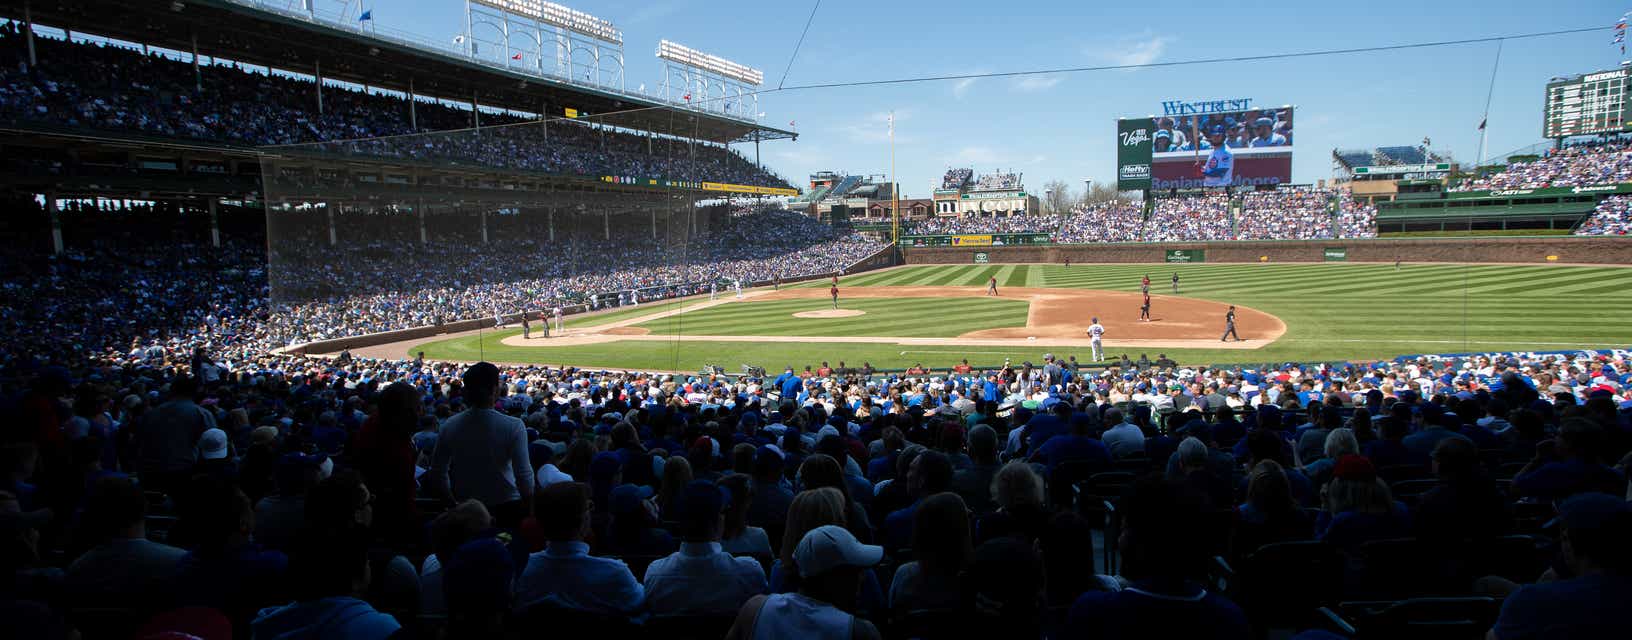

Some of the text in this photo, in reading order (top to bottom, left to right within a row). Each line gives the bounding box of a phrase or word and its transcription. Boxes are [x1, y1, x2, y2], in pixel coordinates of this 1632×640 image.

[1584, 70, 1628, 82] NATIONAL
[1119, 130, 1151, 146] Vegas
[1124, 165, 1147, 173] Hefty
